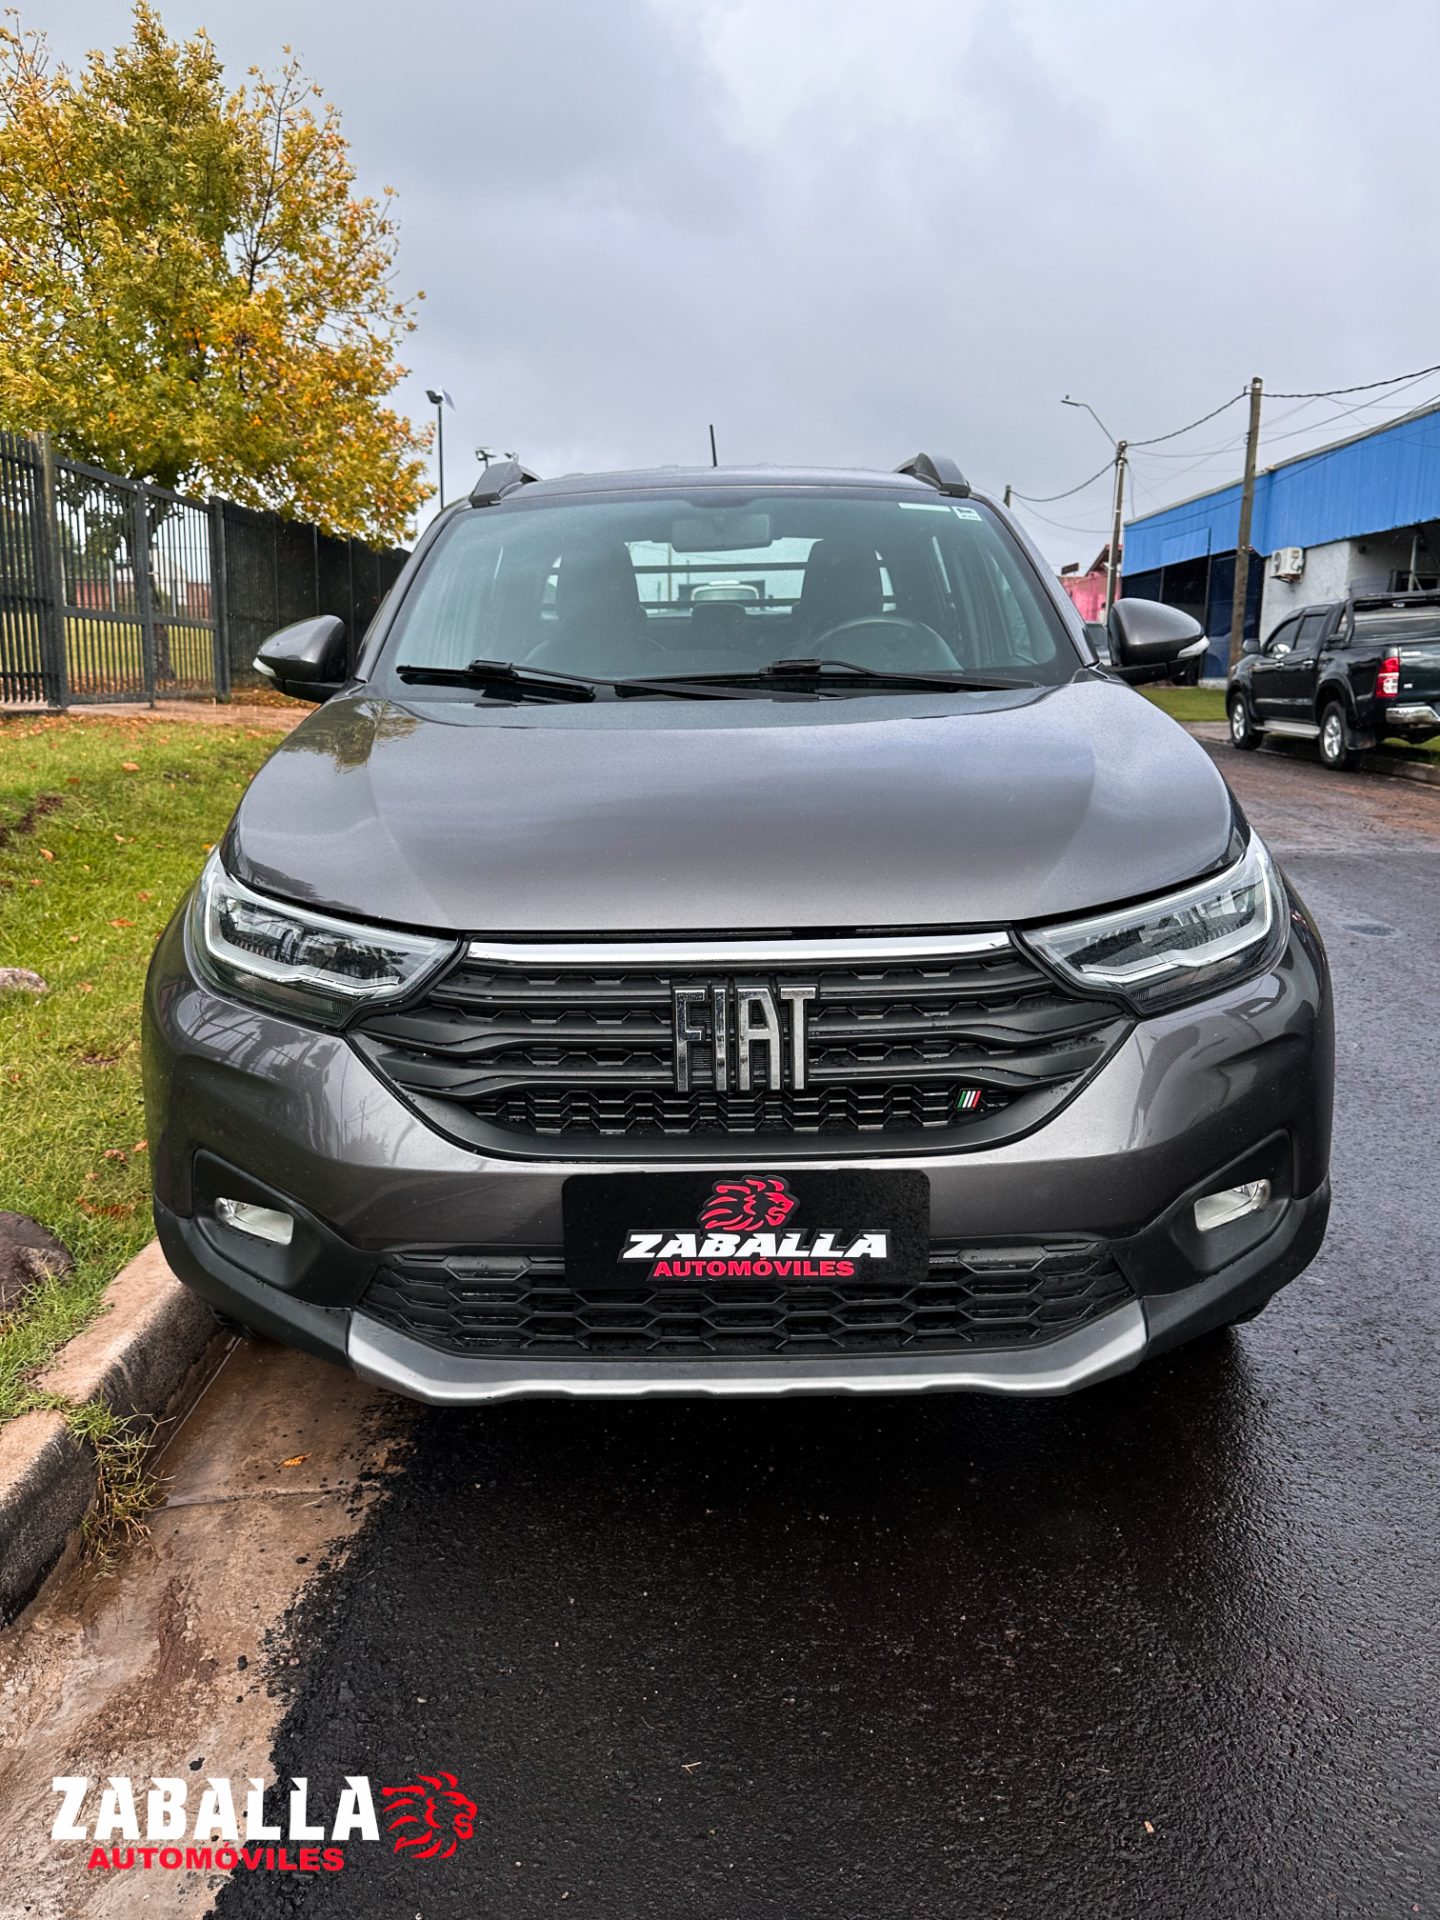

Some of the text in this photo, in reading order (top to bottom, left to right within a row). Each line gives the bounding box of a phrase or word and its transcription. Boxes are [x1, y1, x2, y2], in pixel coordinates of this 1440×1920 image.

[674, 987, 817, 1091] FIAT
[622, 1232, 887, 1259] ZABALLA
[653, 1257, 855, 1277] AUTOMÓVILES
